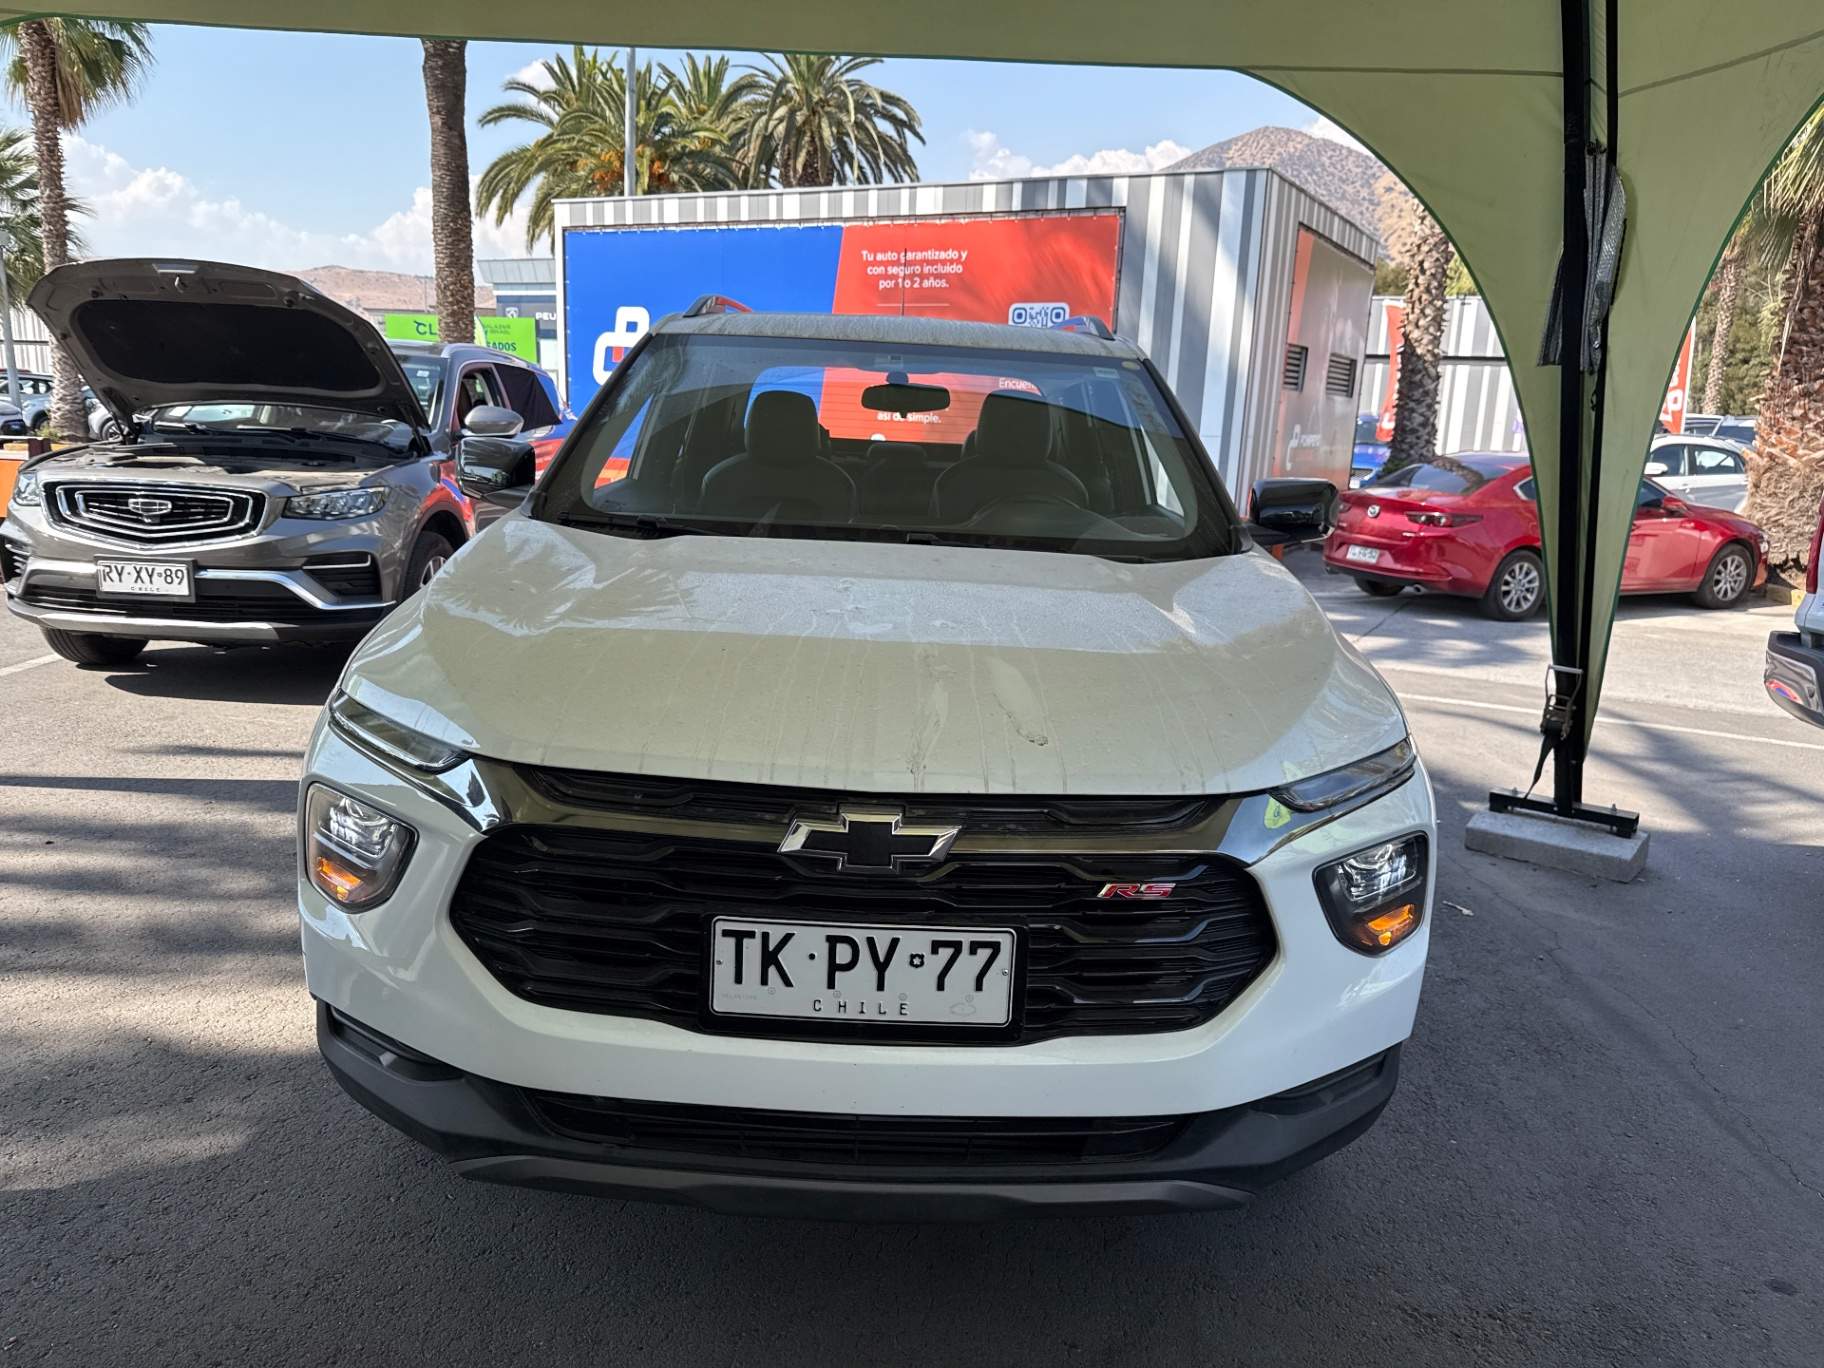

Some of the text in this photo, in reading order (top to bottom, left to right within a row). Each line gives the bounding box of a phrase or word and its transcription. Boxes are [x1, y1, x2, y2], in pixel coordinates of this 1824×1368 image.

[861, 248, 968, 263] Tu auto garantizado y
[867, 263, 963, 277] con seguro incluido
[879, 279, 895, 291] por
[904, 280, 911, 288] o
[913, 277, 920, 288] 2
[922, 277, 949, 288] años.
[535, 311, 557, 321] PEU
[906, 411, 942, 425] simple.
[1096, 882, 1177, 898] RS
[812, 999, 909, 1016] CHILE
